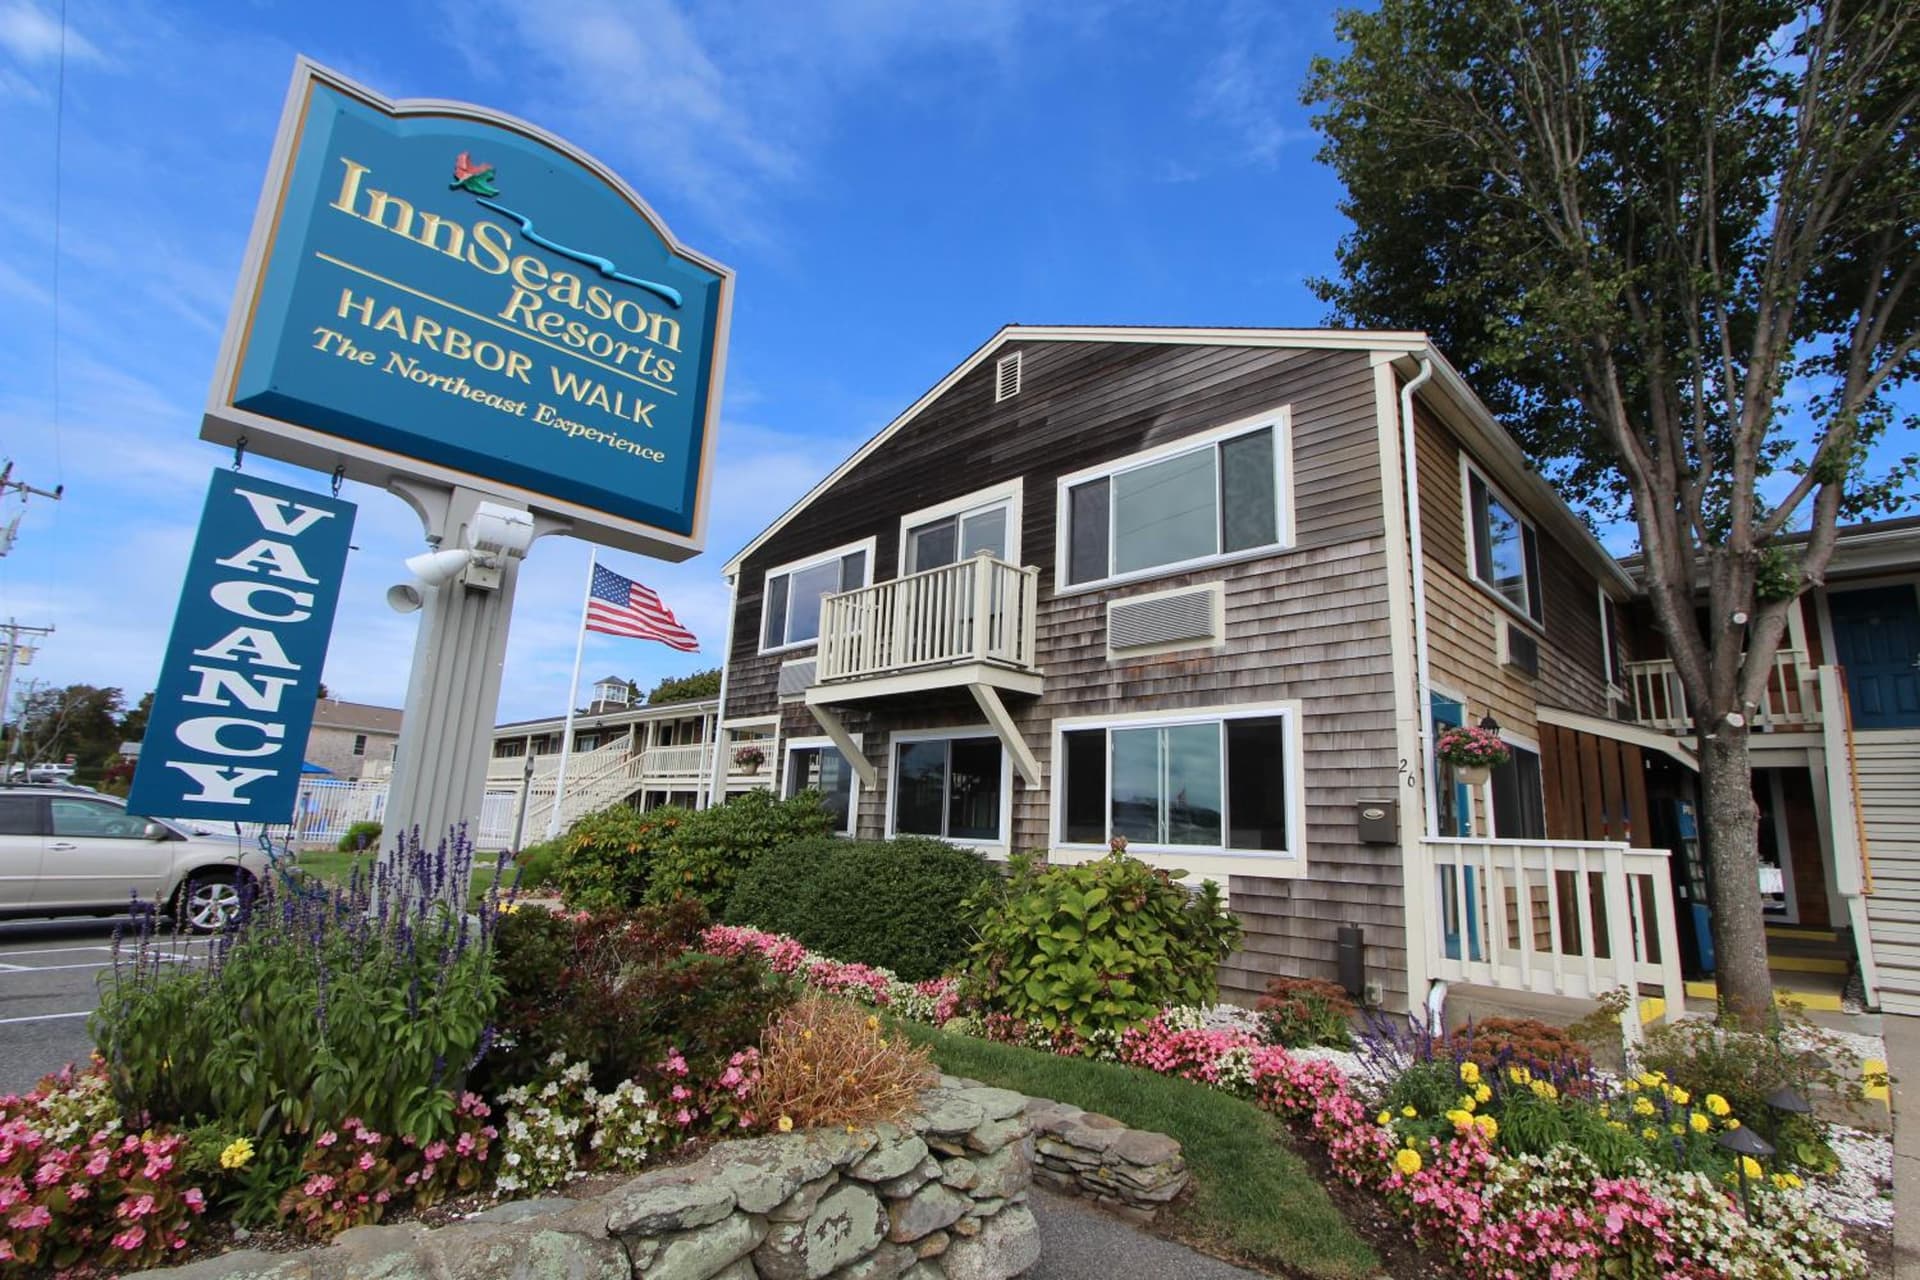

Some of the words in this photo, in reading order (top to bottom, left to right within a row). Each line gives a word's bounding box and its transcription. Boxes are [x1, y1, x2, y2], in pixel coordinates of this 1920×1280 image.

[329, 157, 682, 352] InnSeason
[312, 326, 376, 365] The
[382, 352, 527, 416] Northeast
[532, 403, 665, 463] Experience
[338, 288, 532, 384] HARBOR
[551, 366, 656, 428] WALK
[498, 285, 675, 382] Resorts
[165, 488, 335, 804] VACANCY
[1399, 758, 1416, 787] 26
